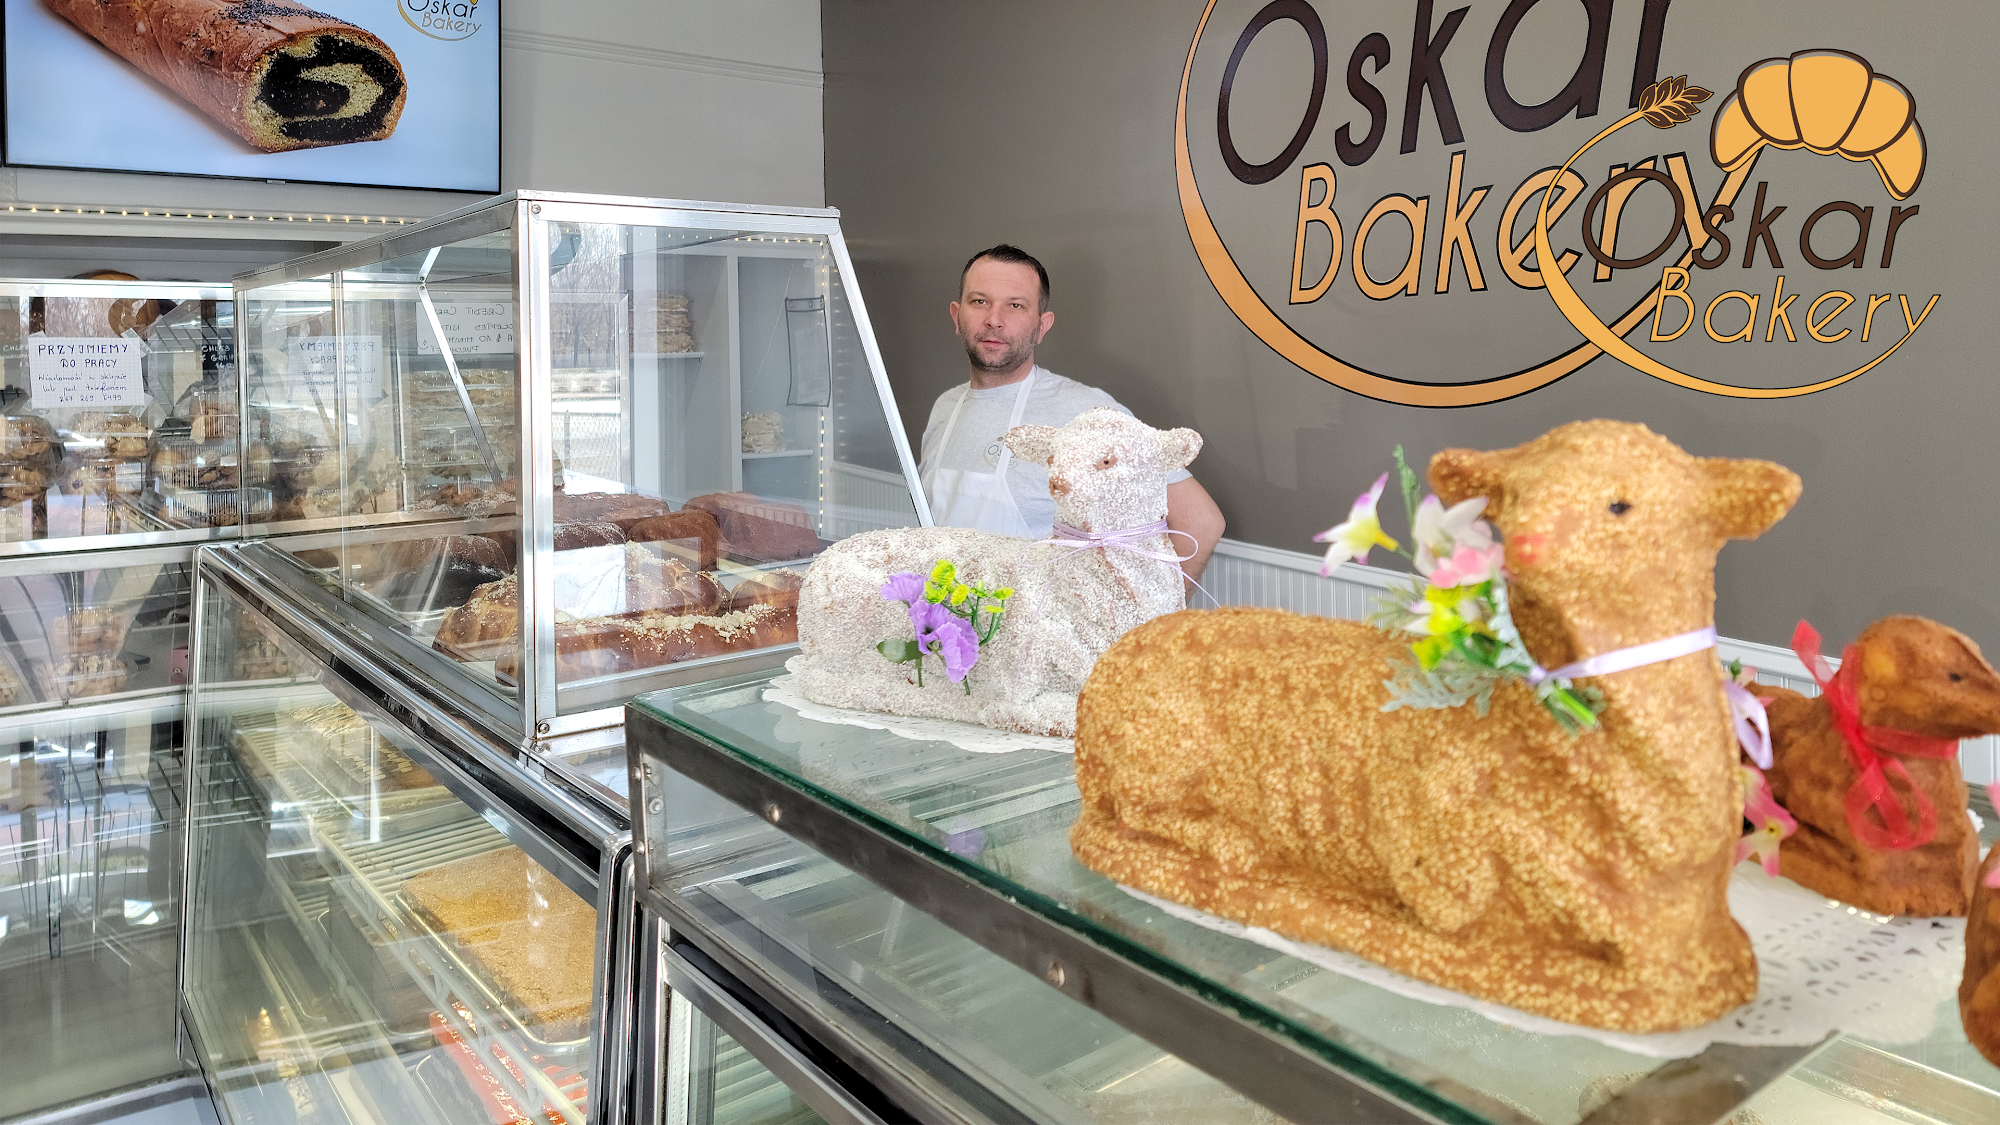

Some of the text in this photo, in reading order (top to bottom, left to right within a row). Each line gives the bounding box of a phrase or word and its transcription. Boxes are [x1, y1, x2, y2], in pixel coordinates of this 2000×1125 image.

[422, 12, 481, 32] Bakery
[1289, 150, 1766, 305] Bakery
[38, 344, 128, 356] PRZYJMIEMY
[60, 359, 117, 368] DO PRACY
